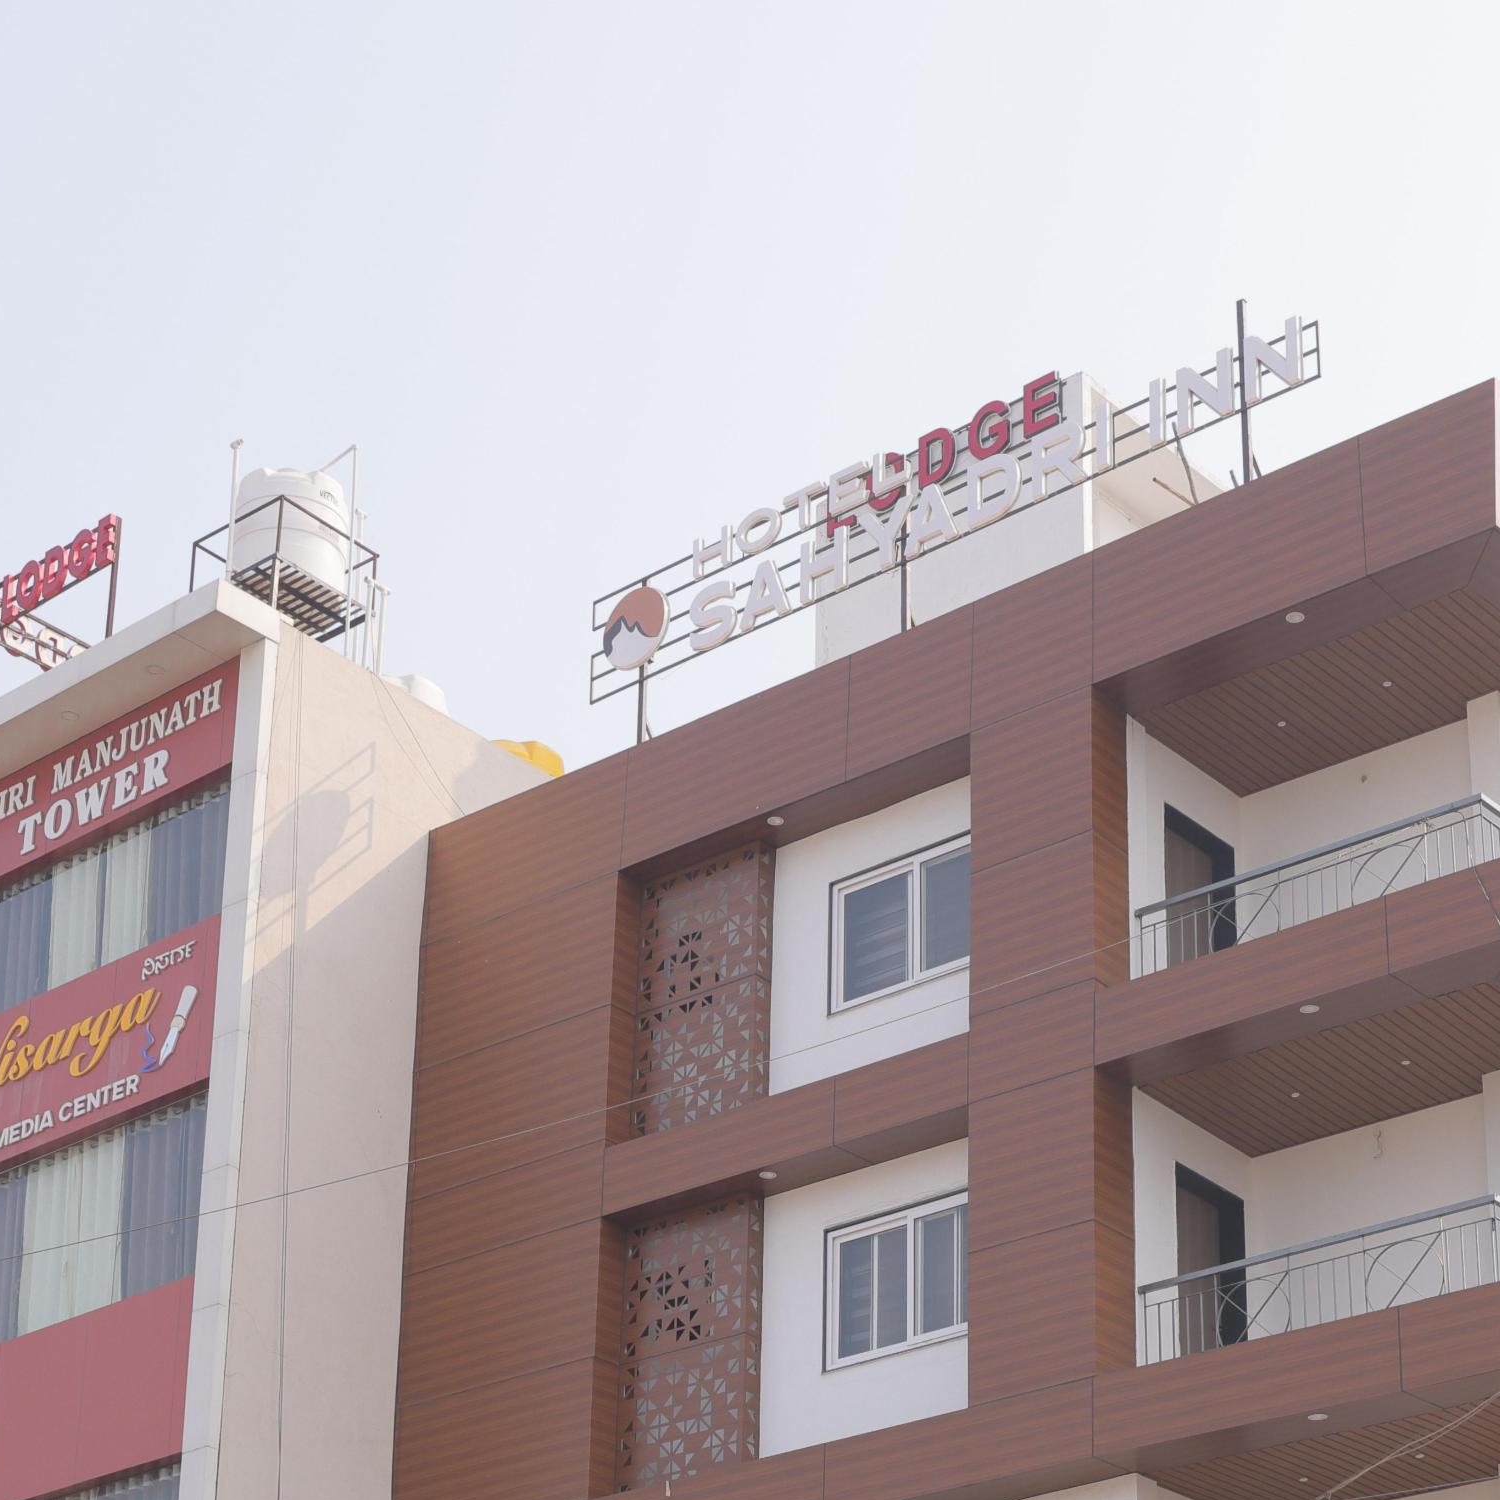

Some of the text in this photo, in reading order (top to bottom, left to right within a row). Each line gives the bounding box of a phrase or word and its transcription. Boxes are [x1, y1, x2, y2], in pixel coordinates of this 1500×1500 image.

[1150, 314, 1303, 450] INN
[2, 512, 120, 621] LODGE
[688, 402, 1116, 653] SAHYADRI
[692, 450, 912, 582] HOTEL
[51, 679, 223, 797] MANJUNATH
[17, 749, 171, 856] TOWER
[58, 1073, 140, 1123] CENTER
